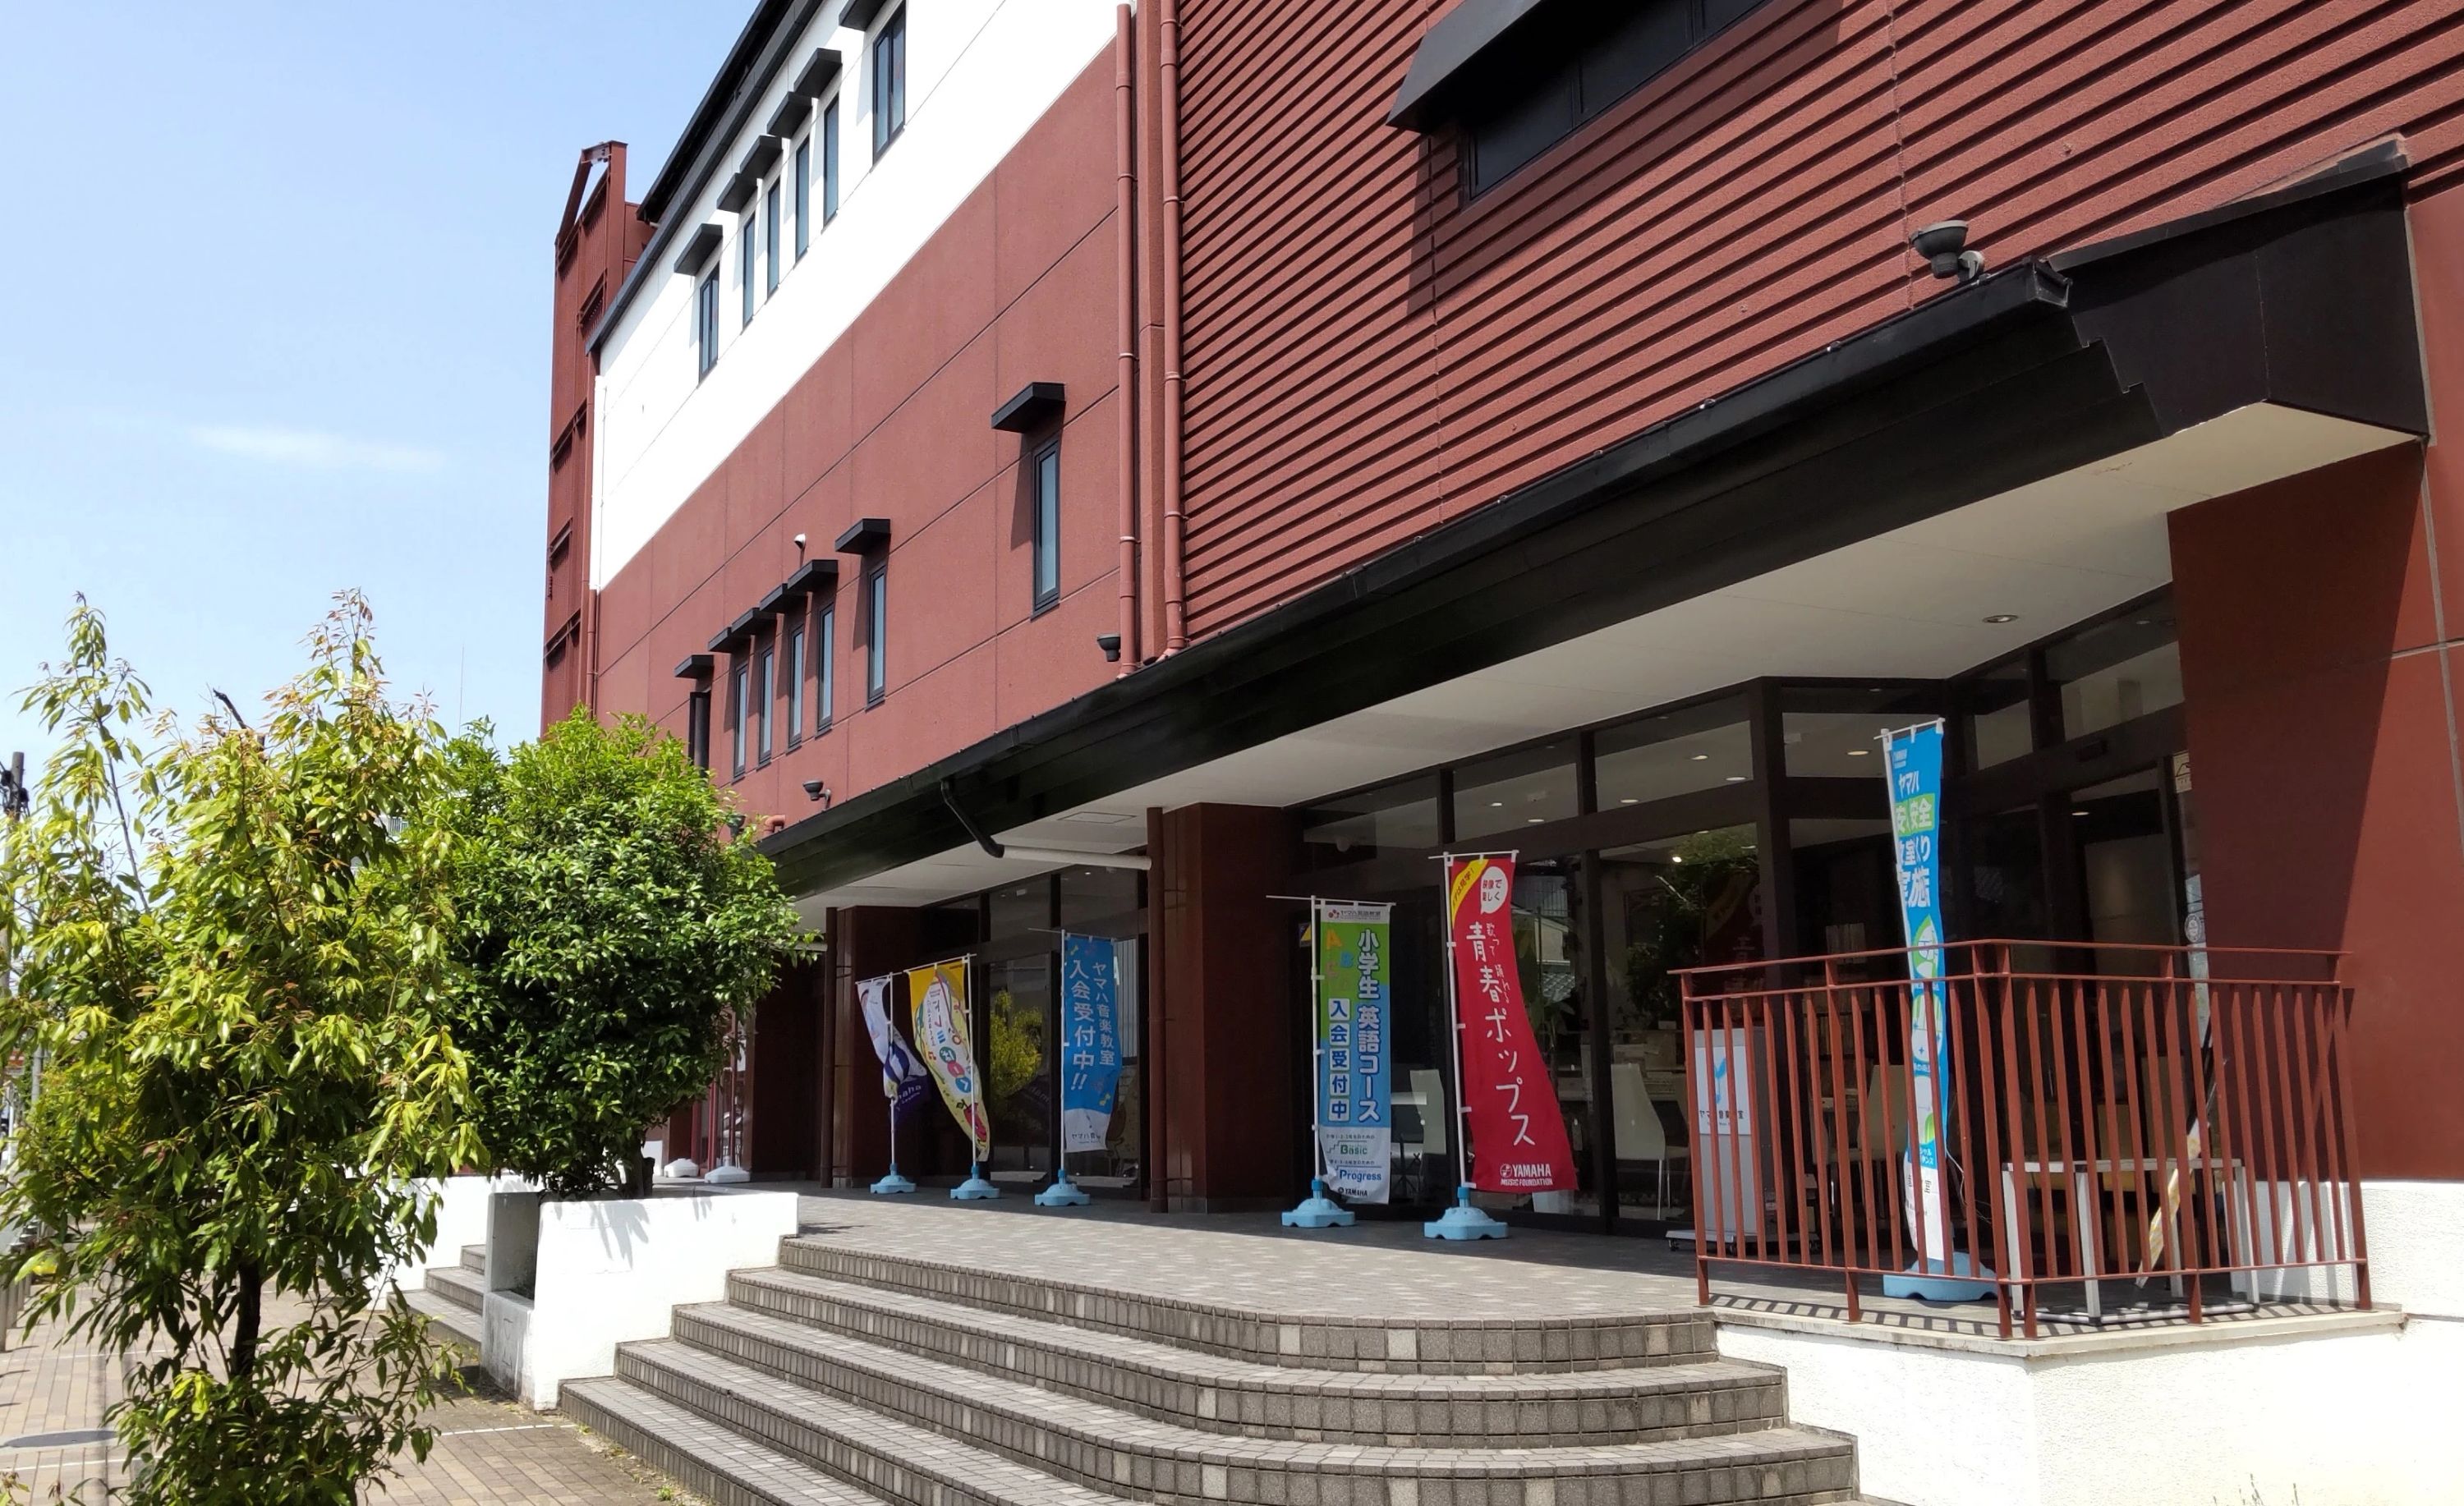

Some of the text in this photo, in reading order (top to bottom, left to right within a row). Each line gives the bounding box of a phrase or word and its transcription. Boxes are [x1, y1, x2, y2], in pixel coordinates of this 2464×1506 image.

[1898, 770, 1919, 799] ヤマハ
[1894, 797, 1933, 833] 安安全
[1092, 962, 1115, 1066] ヤマハ音楽教室
[1466, 921, 1536, 1146] 青春ポップス
[1331, 1000, 1348, 1119] 入会受付中
[1340, 1145, 1368, 1155] Basic
[1340, 1169, 1381, 1182] Progress
[1512, 1164, 1552, 1178] YAMAHA
[1345, 1188, 1368, 1196] YAMAHA
[1501, 1178, 1553, 1187] MUSIC FOUNDATION
